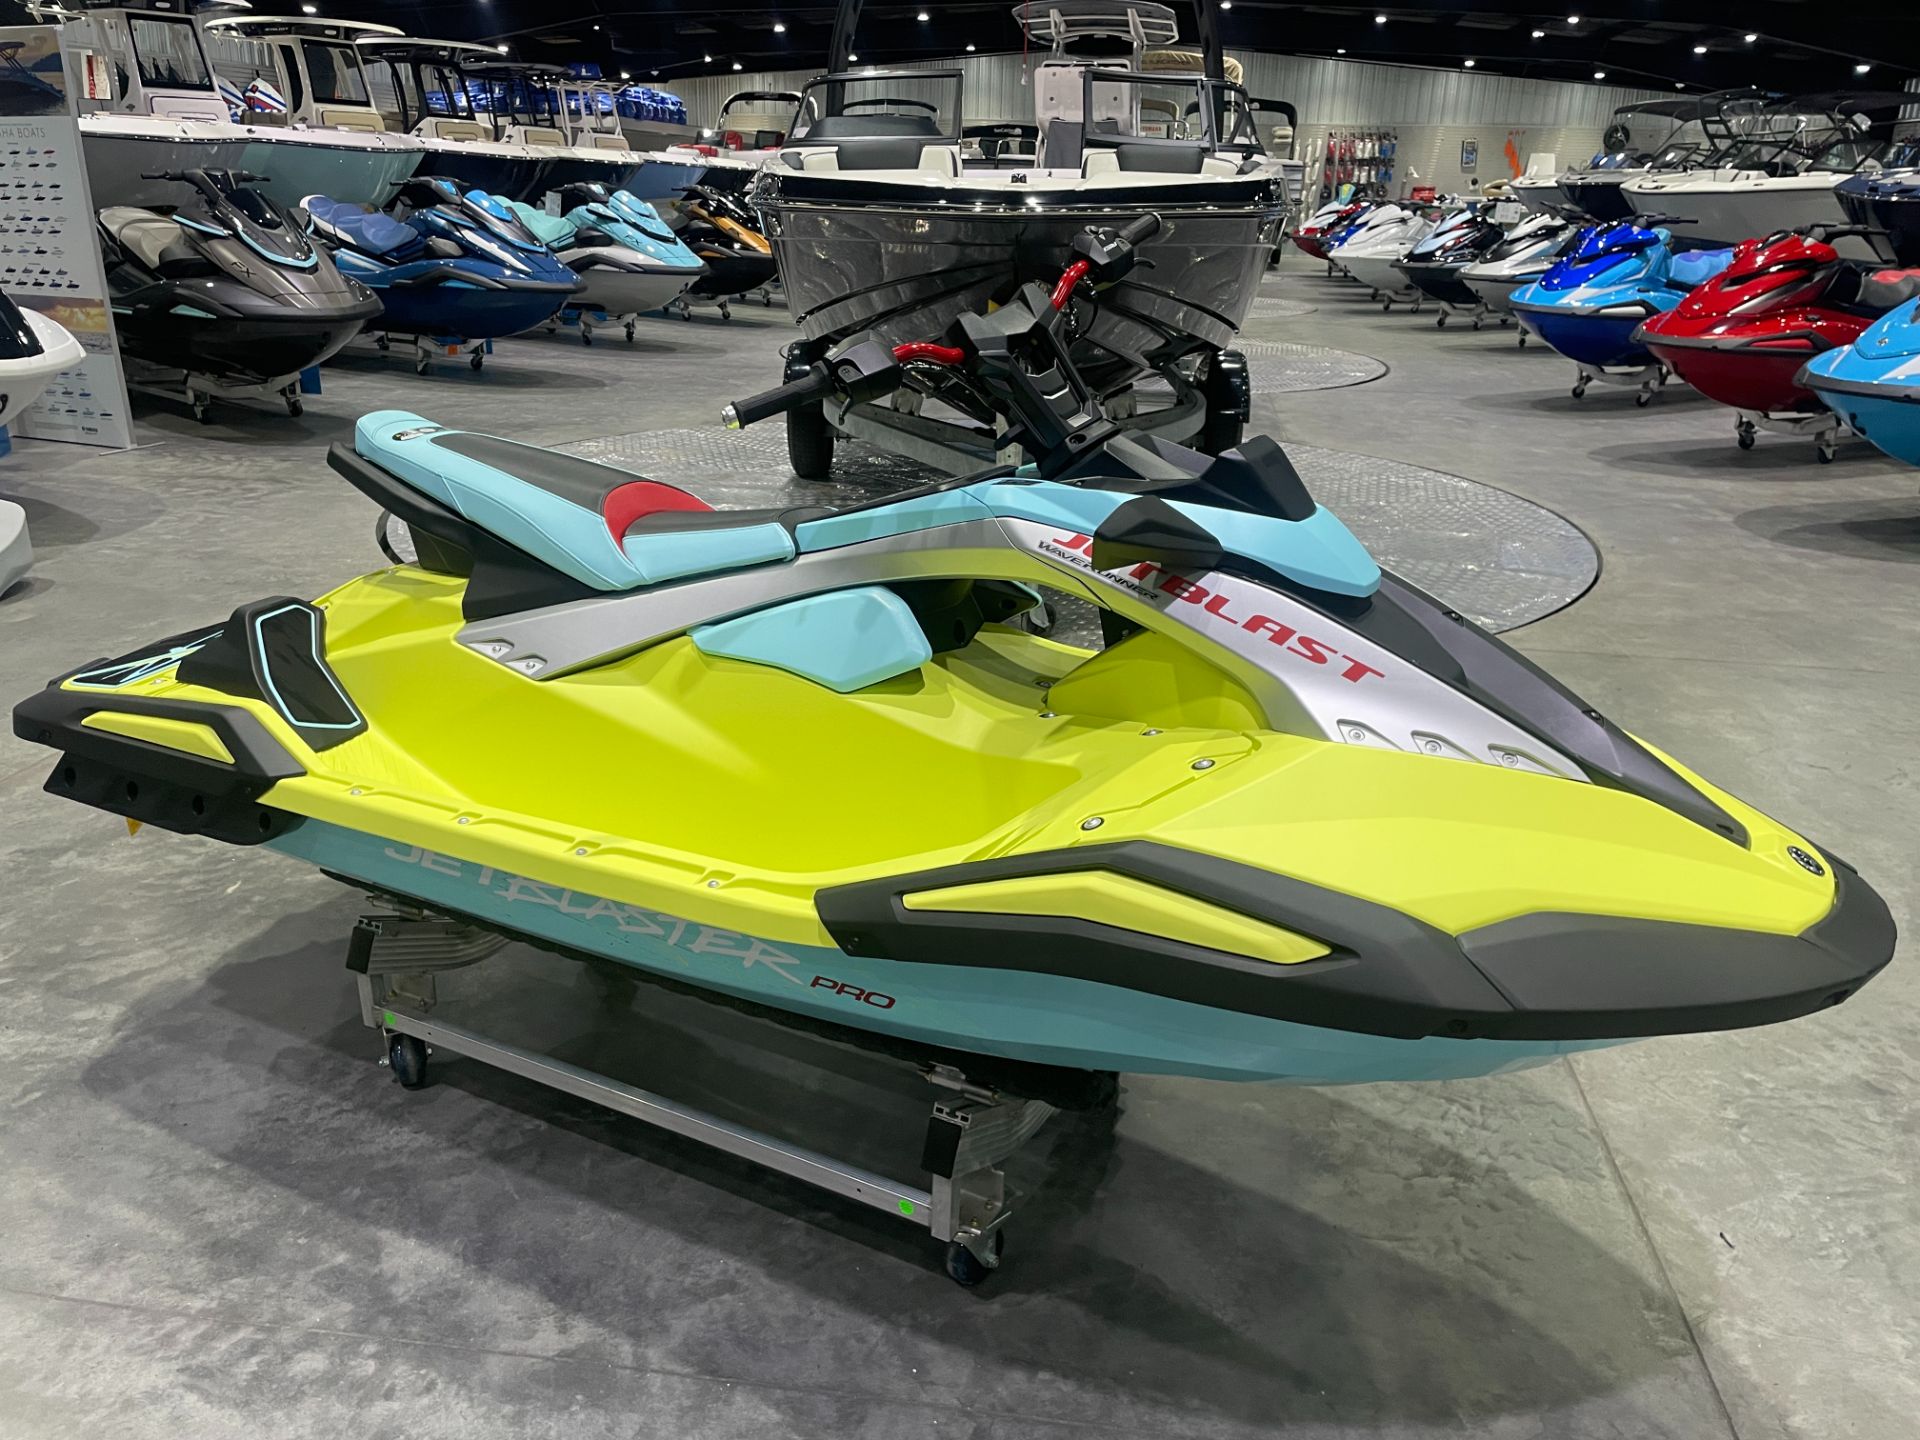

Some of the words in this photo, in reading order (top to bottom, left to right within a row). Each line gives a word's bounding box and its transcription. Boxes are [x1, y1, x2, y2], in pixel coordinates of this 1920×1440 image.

[17, 127, 46, 138] BOATS
[231, 261, 257, 278] FX
[1052, 533, 1386, 684] JTBLAST
[810, 974, 897, 1010] PRO
